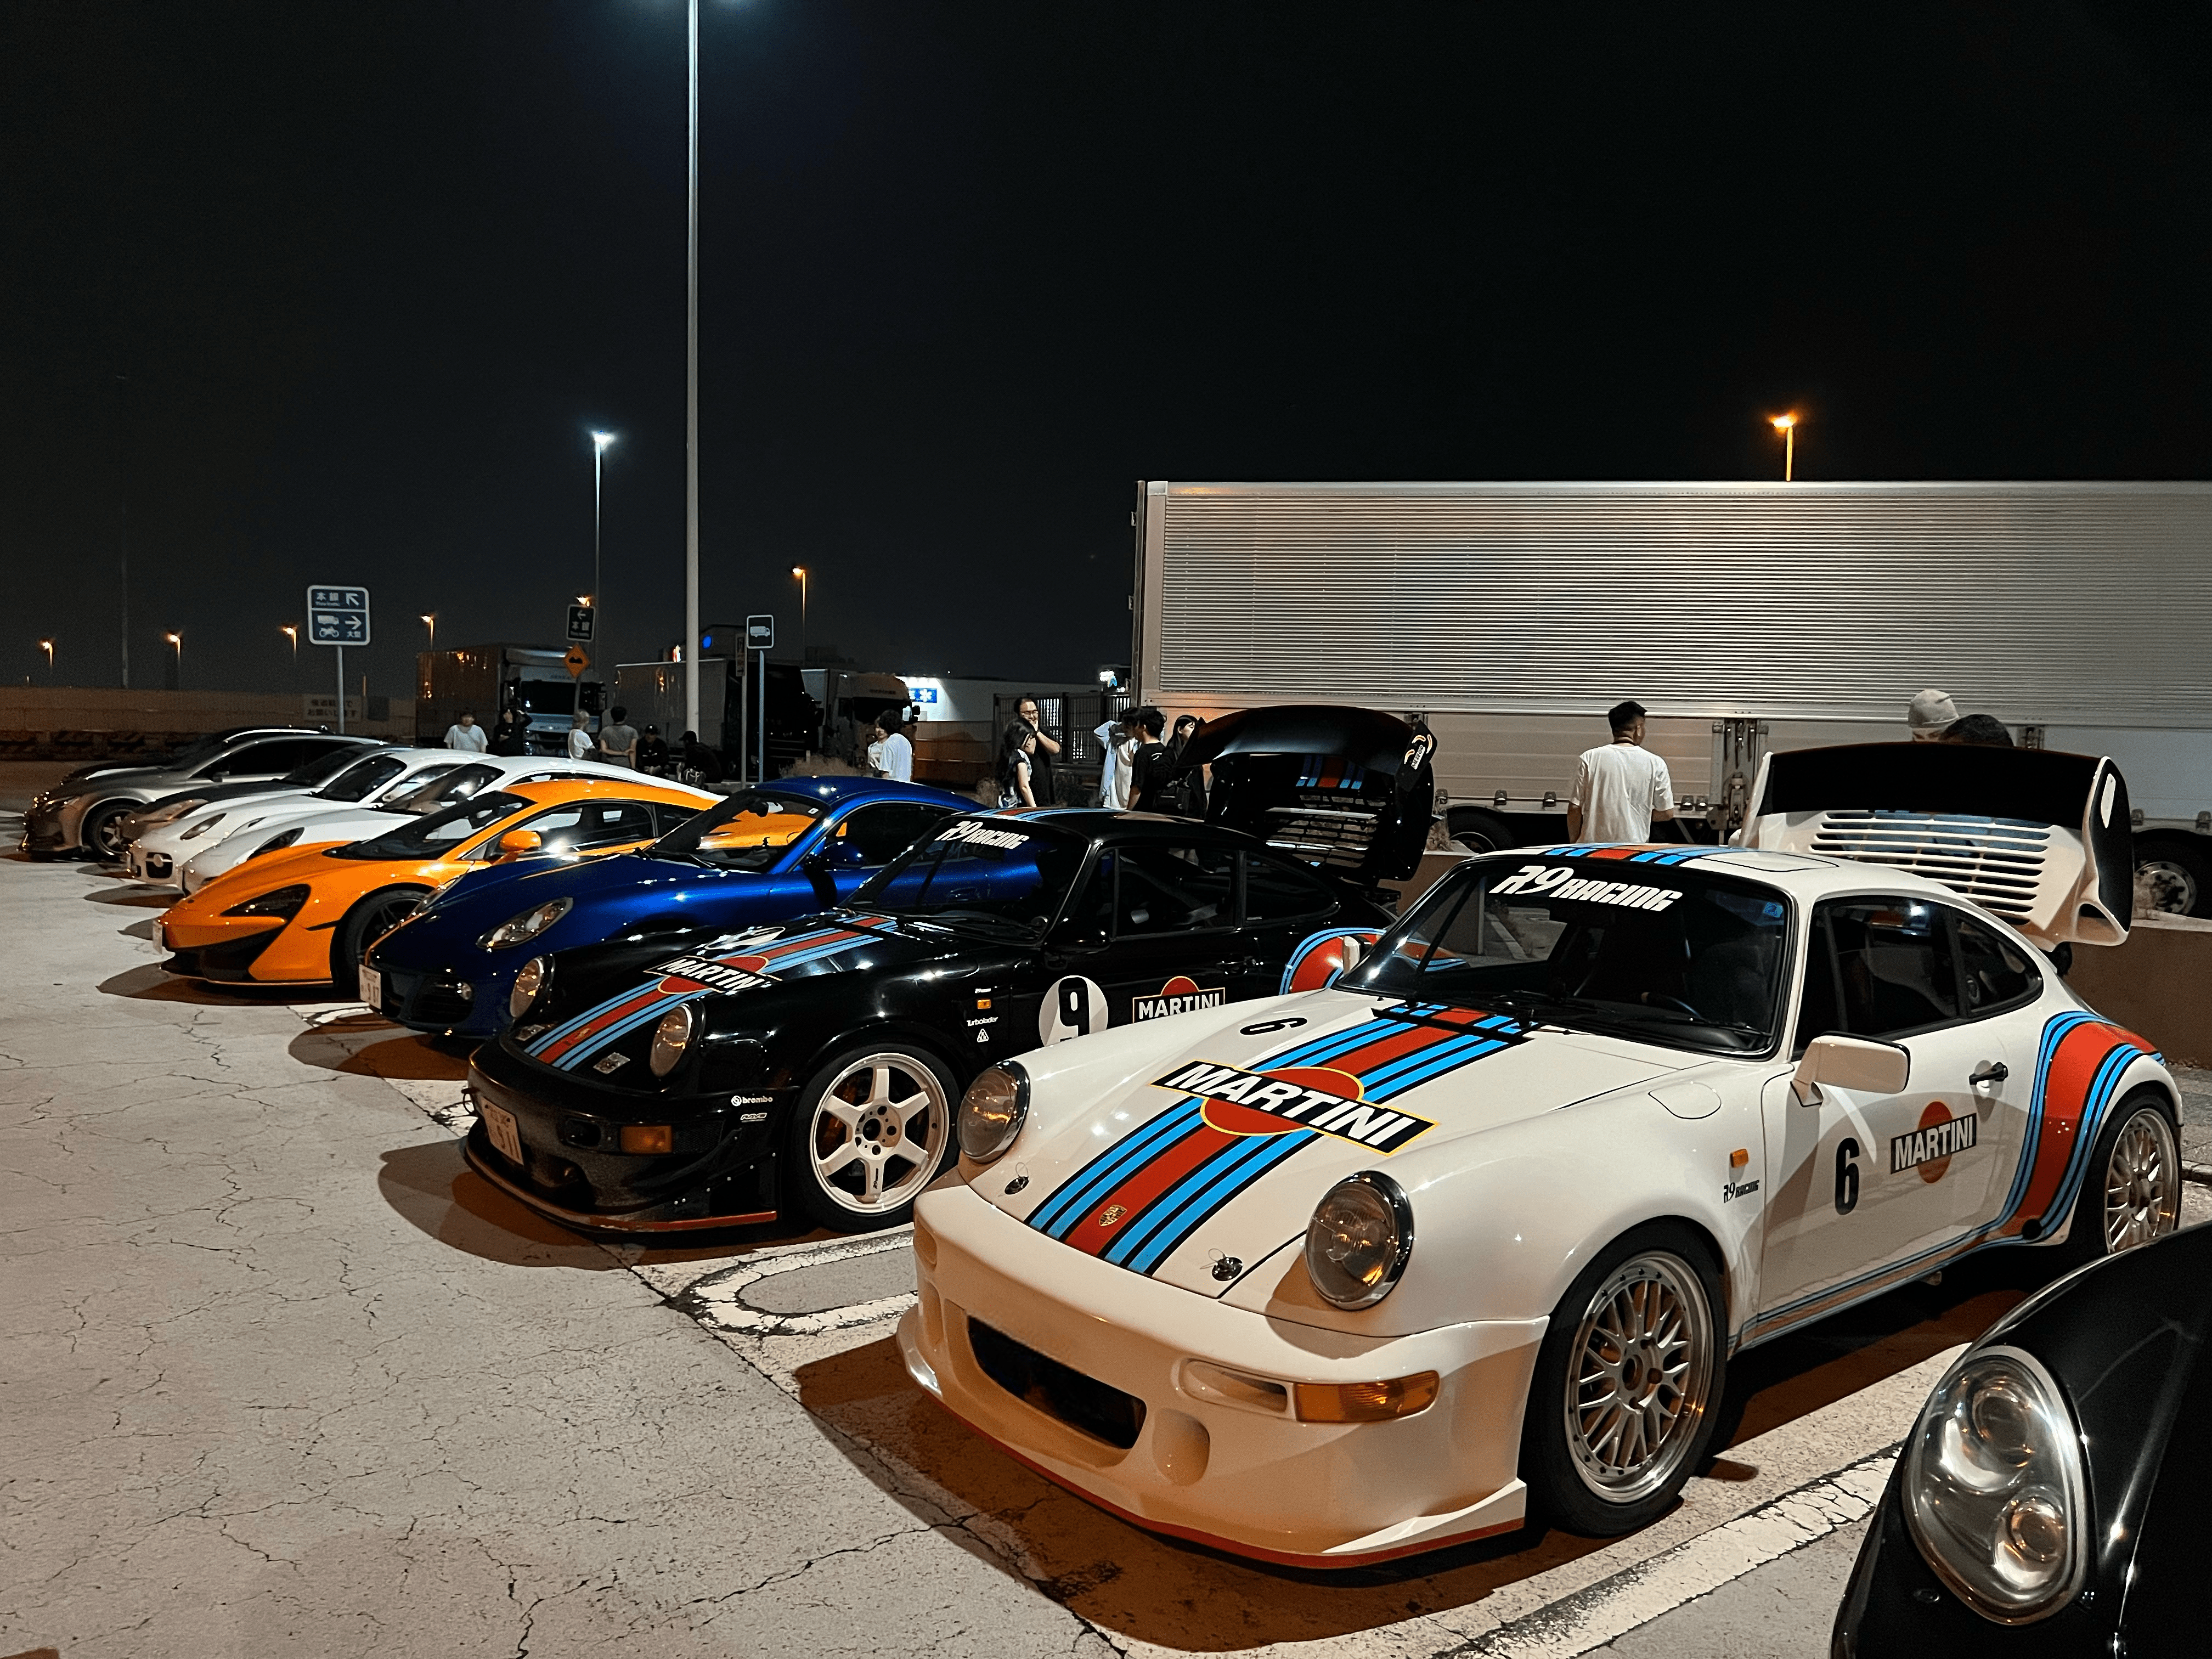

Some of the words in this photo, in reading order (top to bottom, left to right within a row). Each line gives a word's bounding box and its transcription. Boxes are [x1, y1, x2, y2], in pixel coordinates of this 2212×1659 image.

[1058, 977, 1090, 1042] 9
[1138, 992, 1220, 1019] MARTINI
[1240, 1017, 1308, 1035] 6
[1163, 1063, 1416, 1146] MARTINI
[1895, 1116, 1973, 1171] MARTINI
[1835, 1137, 1860, 1215] 6
